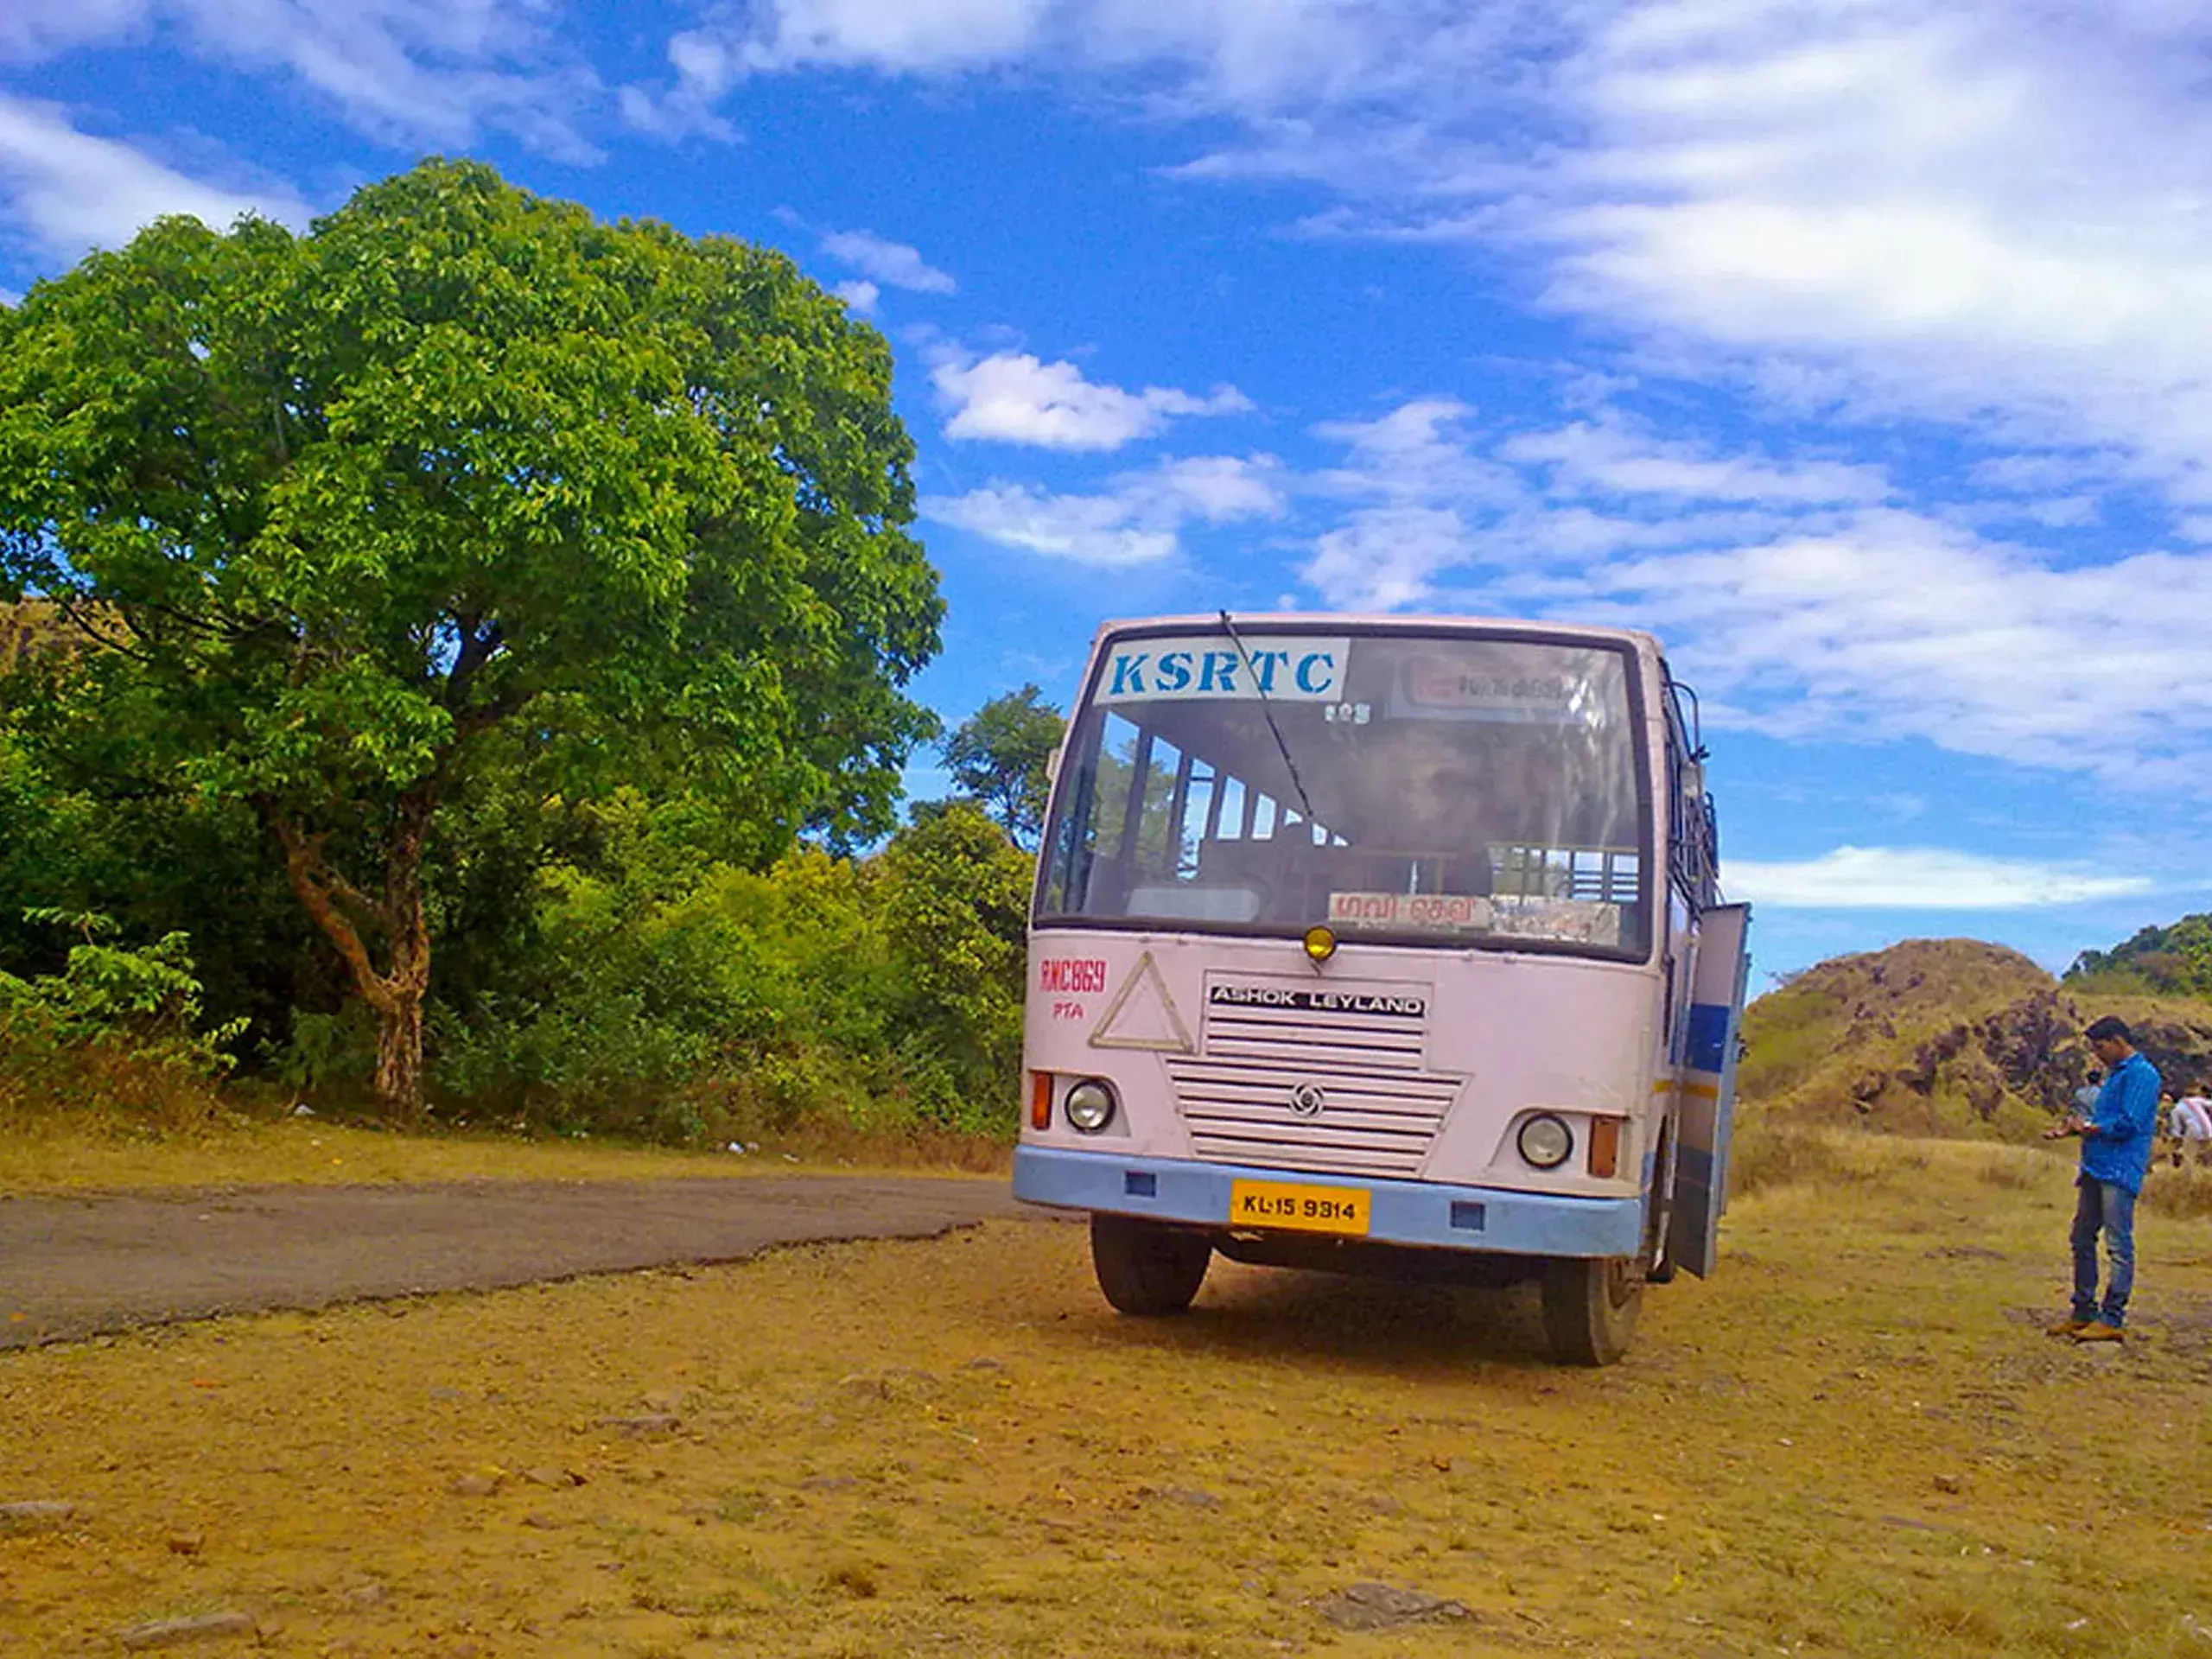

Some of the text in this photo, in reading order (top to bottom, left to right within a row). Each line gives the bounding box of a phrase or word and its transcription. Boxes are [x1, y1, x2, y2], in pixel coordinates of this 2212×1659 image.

[1109, 650, 1335, 695] KSRTC
[1052, 1001, 1084, 1020] PTA
[1213, 986, 1421, 1014] ASHOK LEYLAND
[1303, 1199, 1355, 1220] 9314
